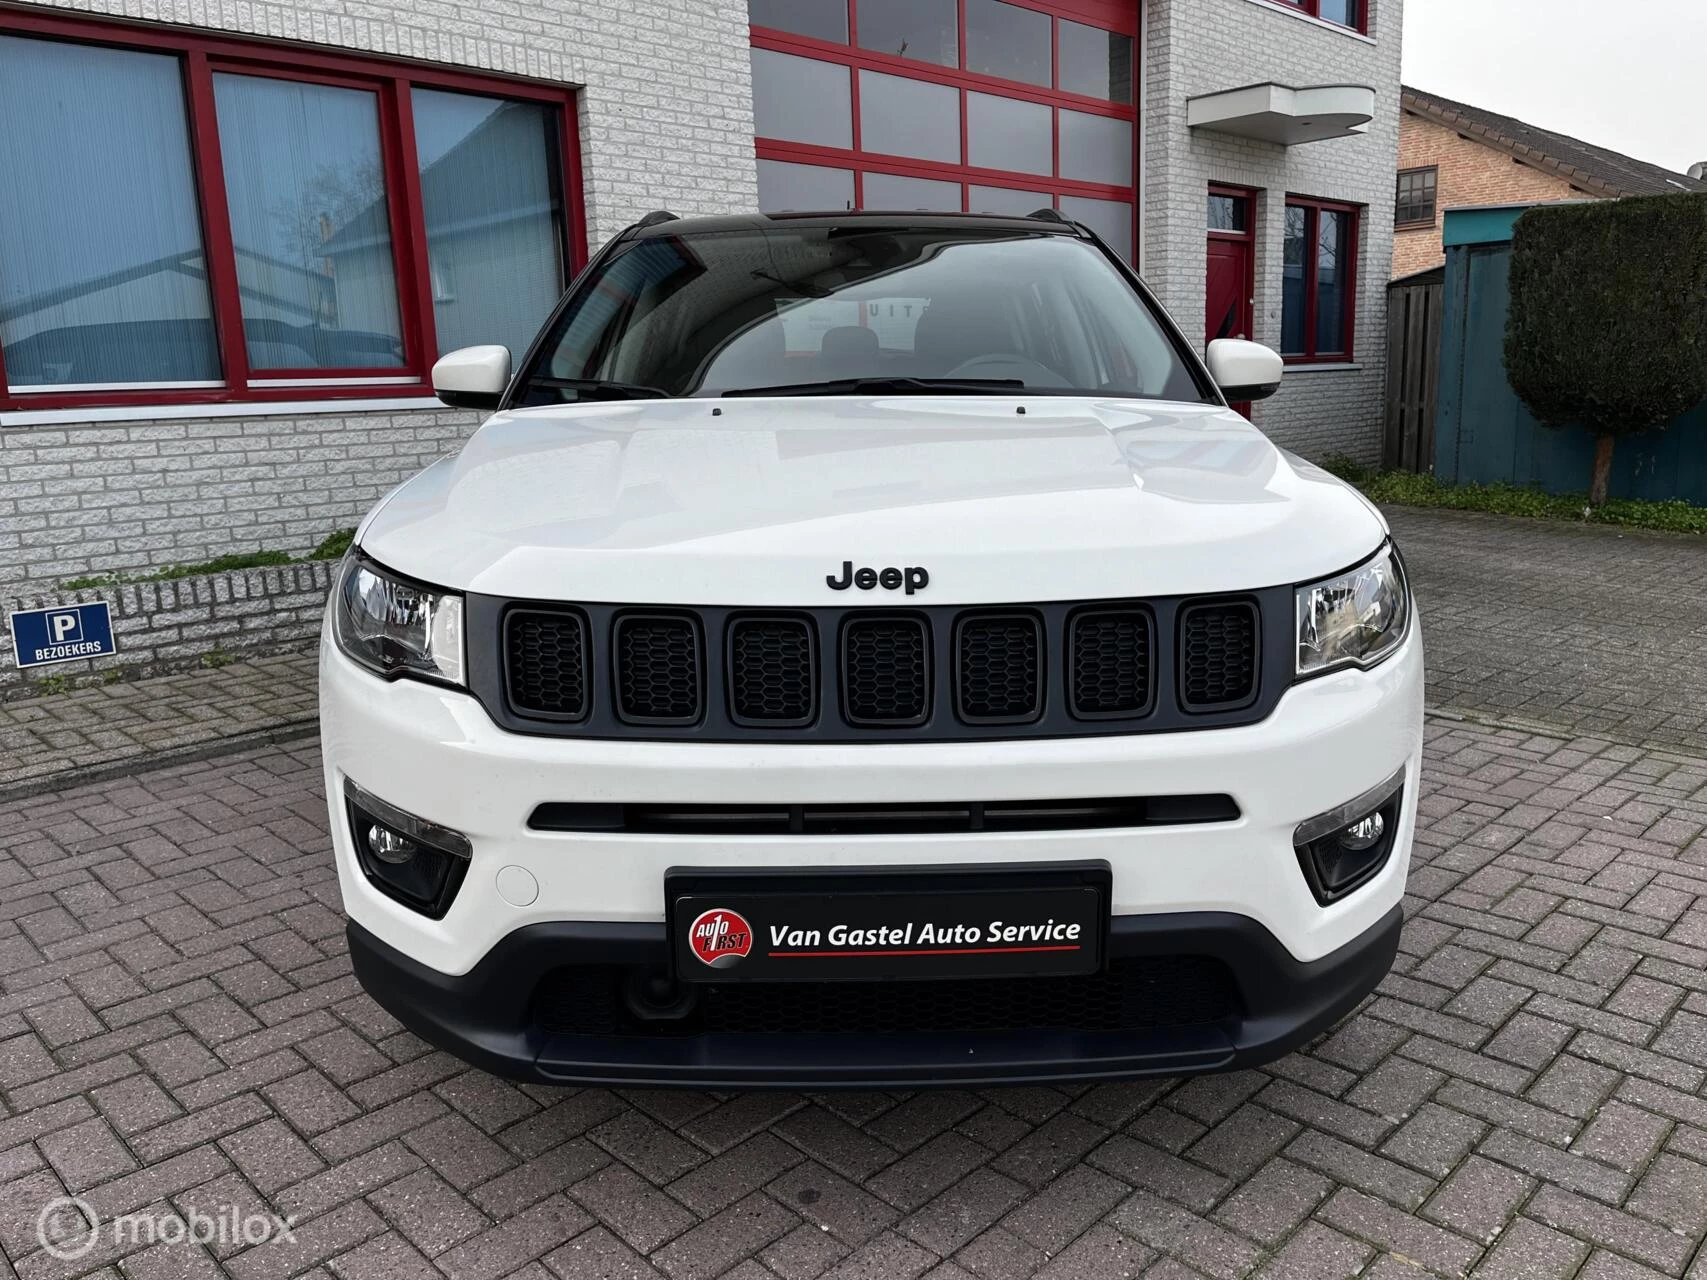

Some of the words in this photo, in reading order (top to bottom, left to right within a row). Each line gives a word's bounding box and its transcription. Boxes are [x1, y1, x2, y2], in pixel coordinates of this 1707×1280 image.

[826, 560, 929, 595] Jeep
[53, 614, 76, 642] P
[35, 640, 102, 661] BEZOEKERS
[769, 925, 821, 946] Van
[828, 922, 913, 946] Gastel
[916, 923, 981, 945] Auto
[986, 918, 1081, 943] Service
